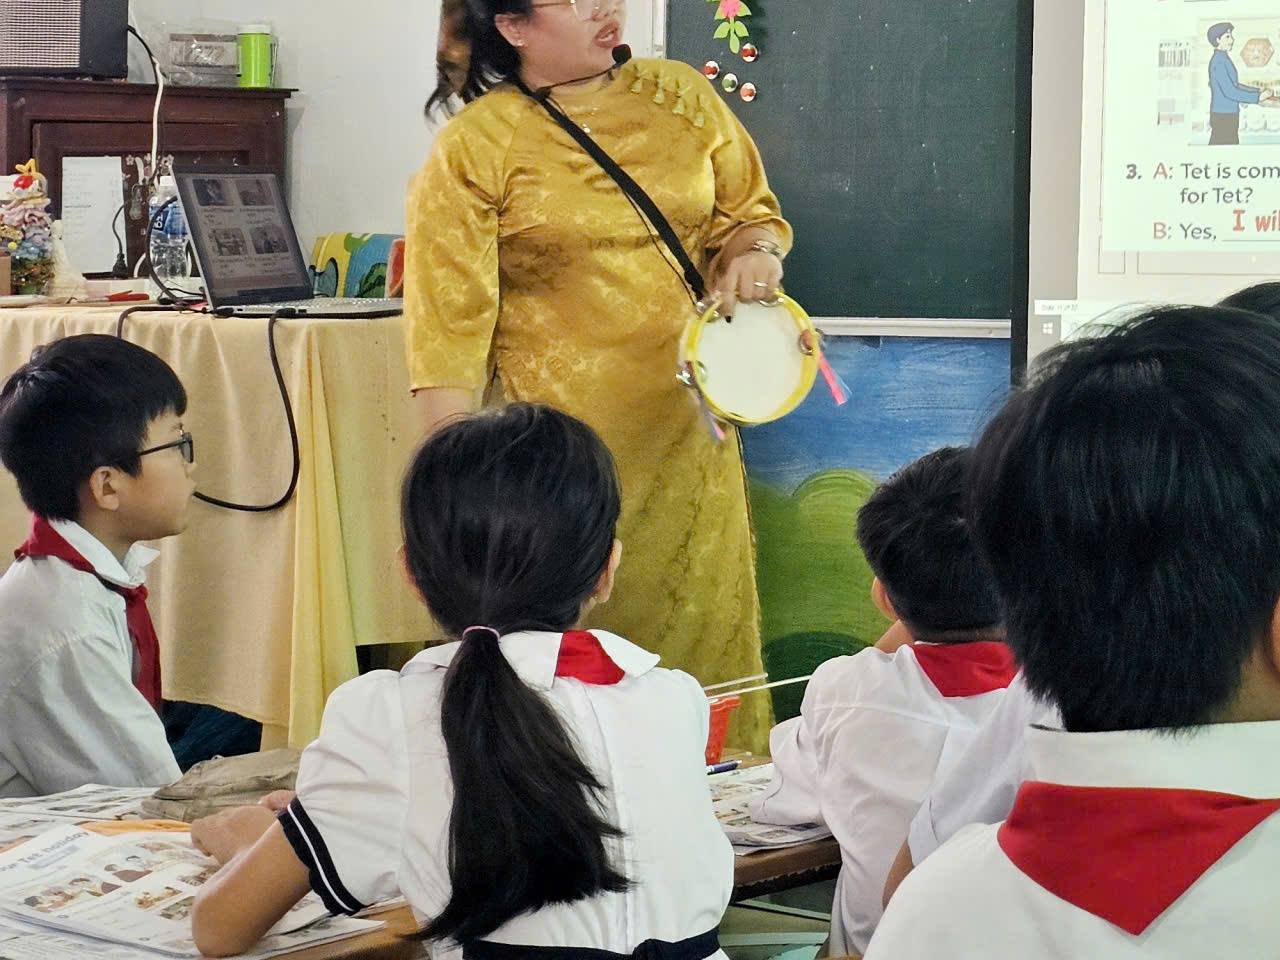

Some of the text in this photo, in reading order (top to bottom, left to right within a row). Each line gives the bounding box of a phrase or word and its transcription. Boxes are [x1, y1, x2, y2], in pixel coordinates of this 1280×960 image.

[1126, 164, 1142, 180] 3.
[1153, 162, 1173, 179] A:
[1181, 163, 1211, 179] Tet
[1217, 162, 1231, 179] is
[1179, 187, 1208, 205] for
[1212, 186, 1253, 204] Tet?
[1153, 222, 1173, 240] B:
[1179, 223, 1218, 243] Yes,
[1233, 208, 1245, 232] I
[42, 831, 89, 853] holiday
